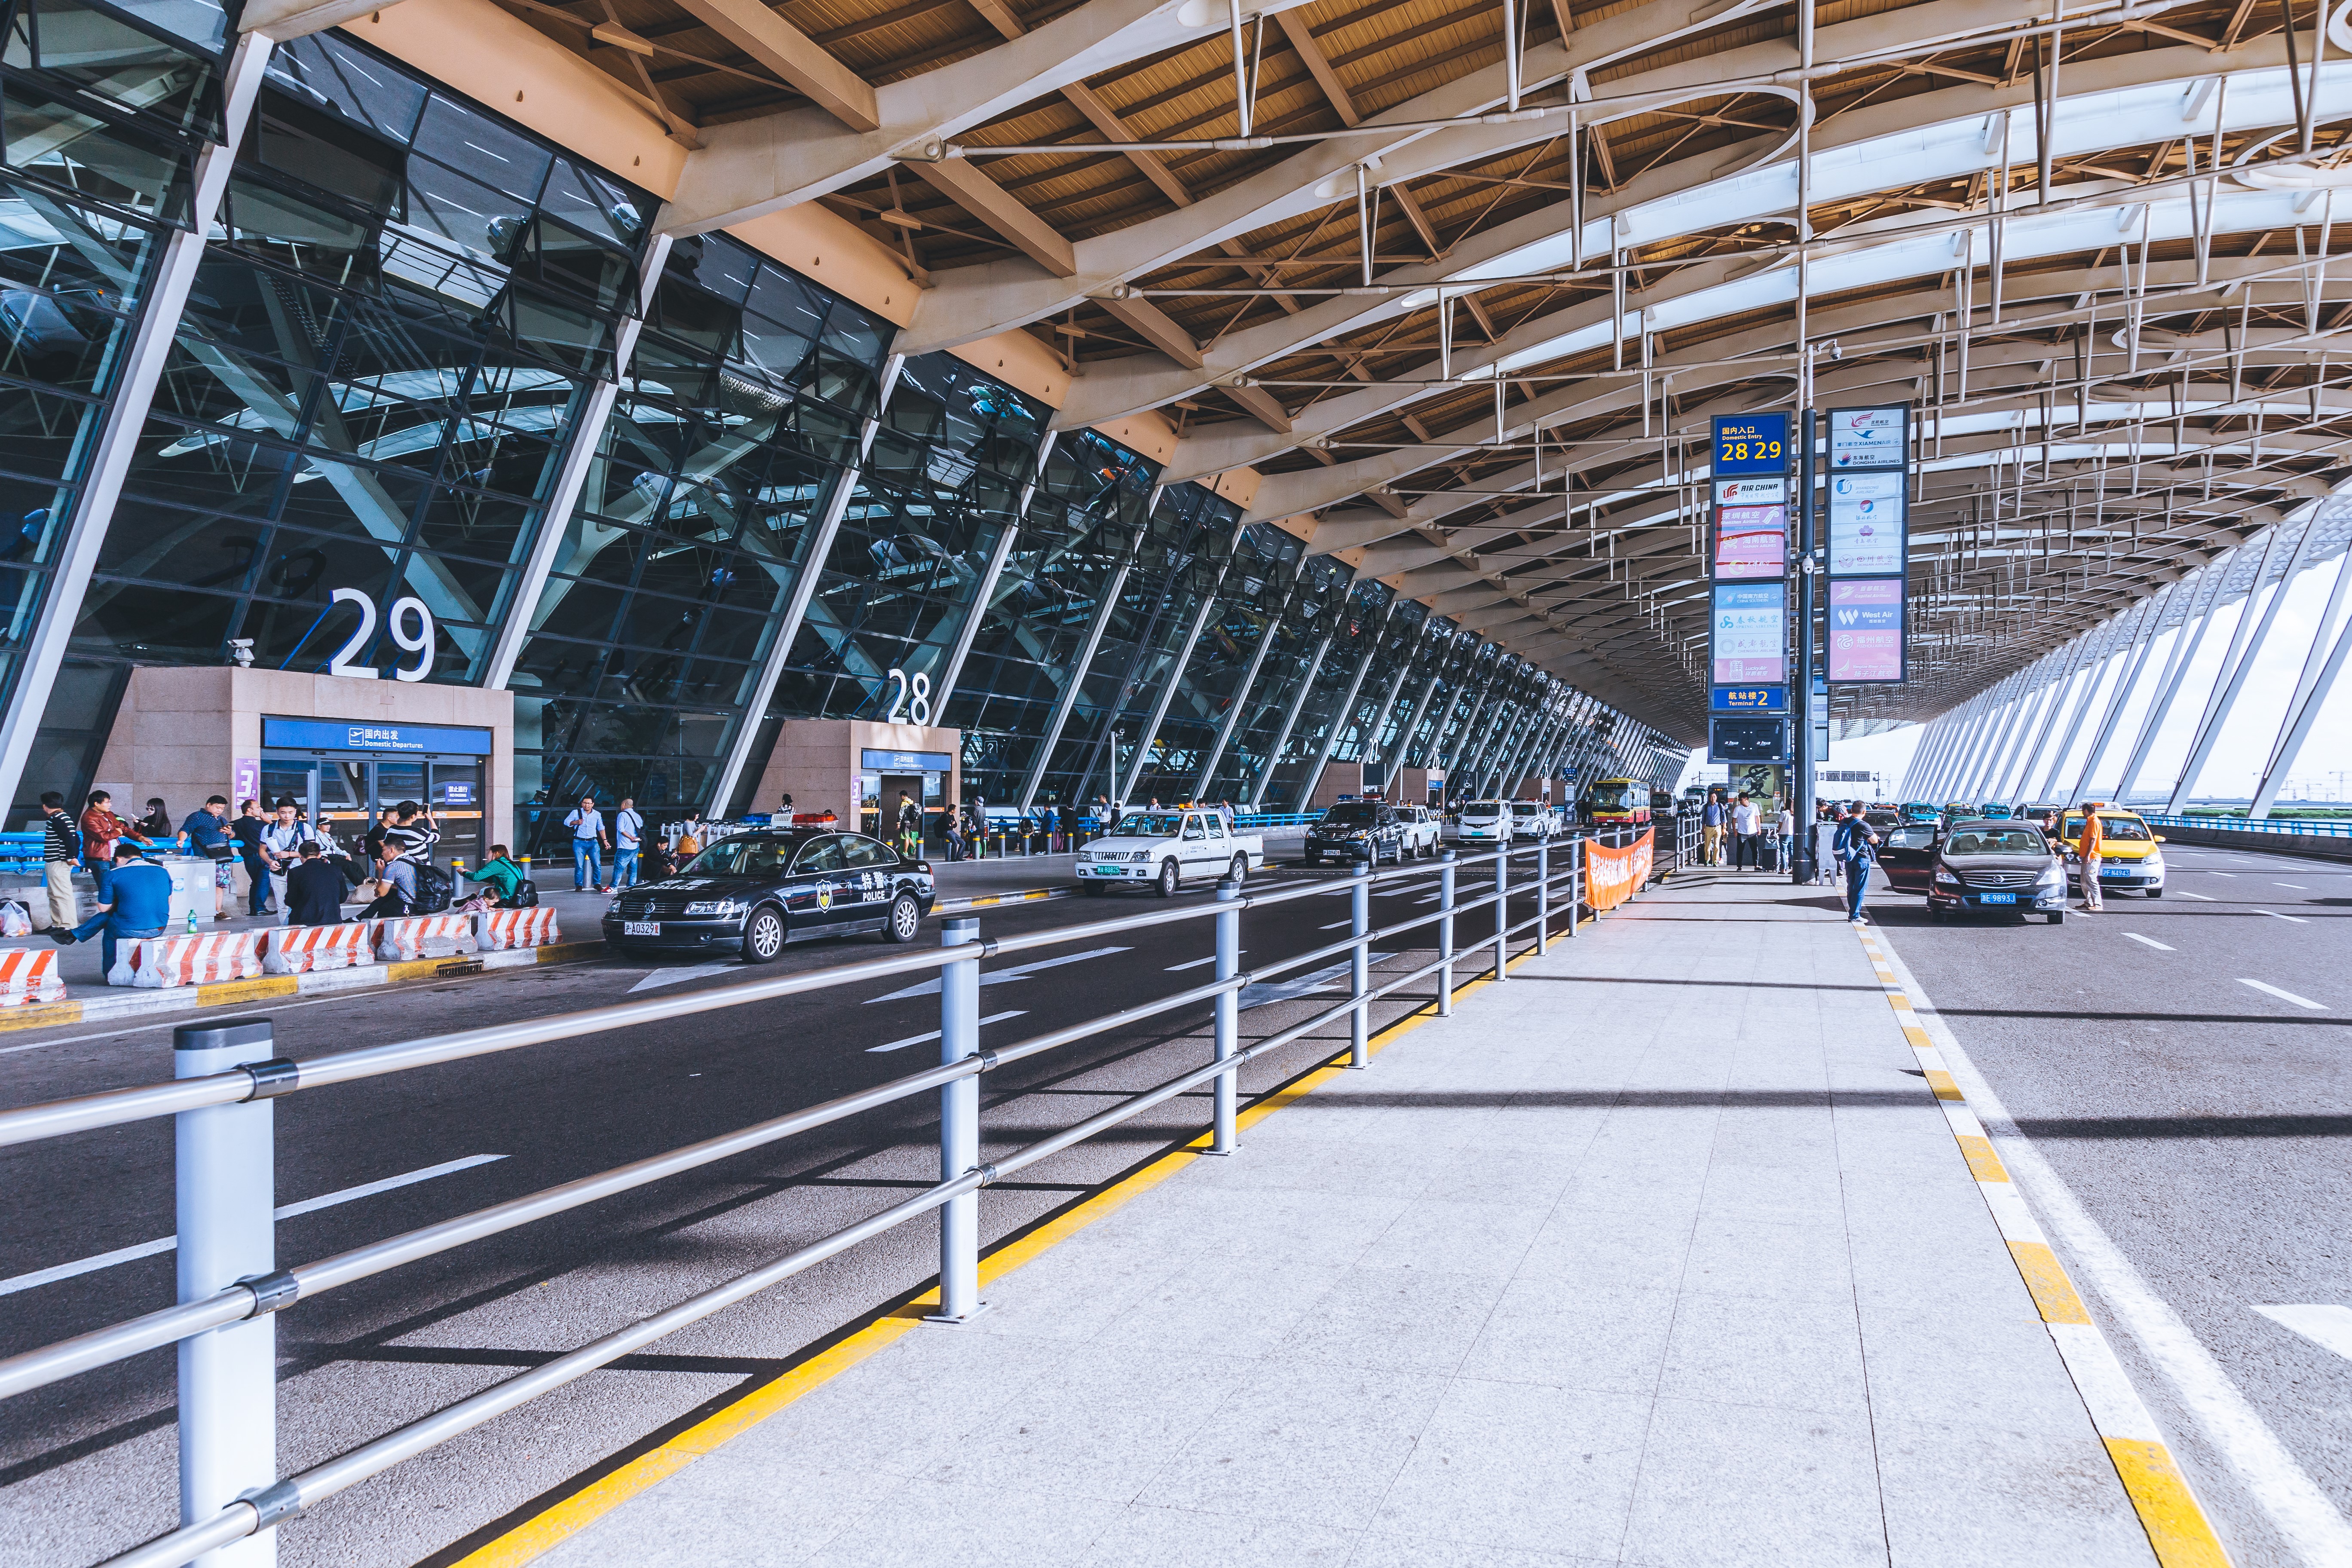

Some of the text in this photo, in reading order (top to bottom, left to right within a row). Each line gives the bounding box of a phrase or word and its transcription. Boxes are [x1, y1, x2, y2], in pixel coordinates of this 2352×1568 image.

[1722, 426, 1755, 435] 国内入口
[1722, 441, 1781, 461] 28 29
[1721, 511, 1760, 519] 深圳航空
[1743, 536, 1776, 544] 海南航空
[1736, 615, 1778, 624] 春秋航空
[330, 588, 435, 682] 29
[1738, 639, 1778, 648] 成都航空
[886, 668, 930, 726] 28
[1758, 691, 1768, 706] 2
[365, 729, 398, 740] 国内出发
[1369, 738, 1378, 764] 27
[861, 871, 885, 890] 特警
[863, 891, 885, 902] POLICE
